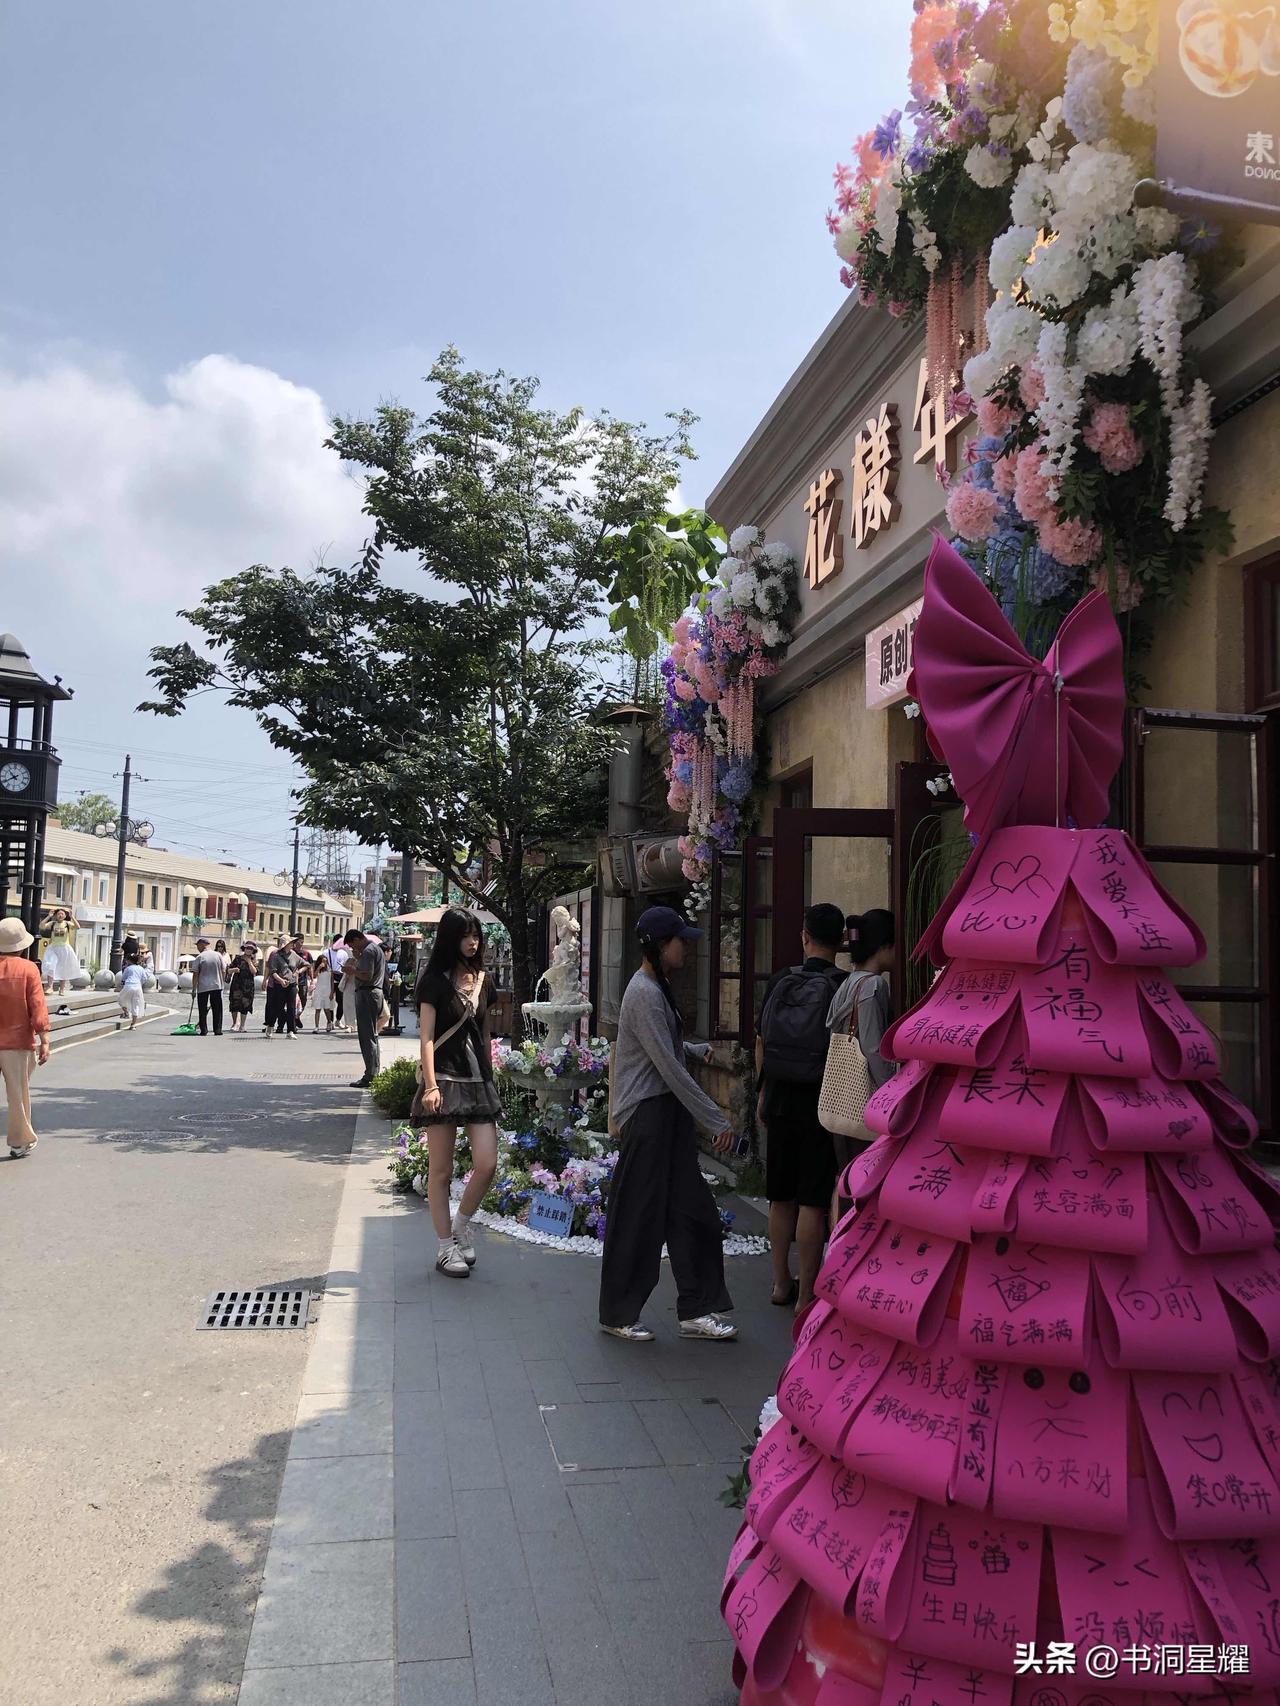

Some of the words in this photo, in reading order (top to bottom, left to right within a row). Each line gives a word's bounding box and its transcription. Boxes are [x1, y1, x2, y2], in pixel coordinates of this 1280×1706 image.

[1245, 130, 1280, 163] 東
[880, 615, 920, 686] 原创
[1089, 834, 1173, 951] 我爱大连
[960, 911, 1038, 932] 比心
[1030, 943, 1124, 1063] 有福气
[905, 1016, 984, 1048] 身体健康
[1142, 979, 1216, 1071] 毕业啦
[536, 1204, 567, 1223] 禁止踩踏
[1033, 1187, 1134, 1219] 笑容满面
[856, 1284, 913, 1314] 你要开心
[1004, 1280, 1028, 1301] 福
[1116, 1275, 1202, 1322] 向前
[970, 1313, 1073, 1347] 福气满满
[963, 1364, 999, 1482] 学业有成
[1008, 1456, 1112, 1498] 八方来财
[787, 1506, 861, 1581] 越来越美
[922, 1591, 1020, 1648] 生日快乐
[1075, 1608, 1199, 1648] 没有烦恼
